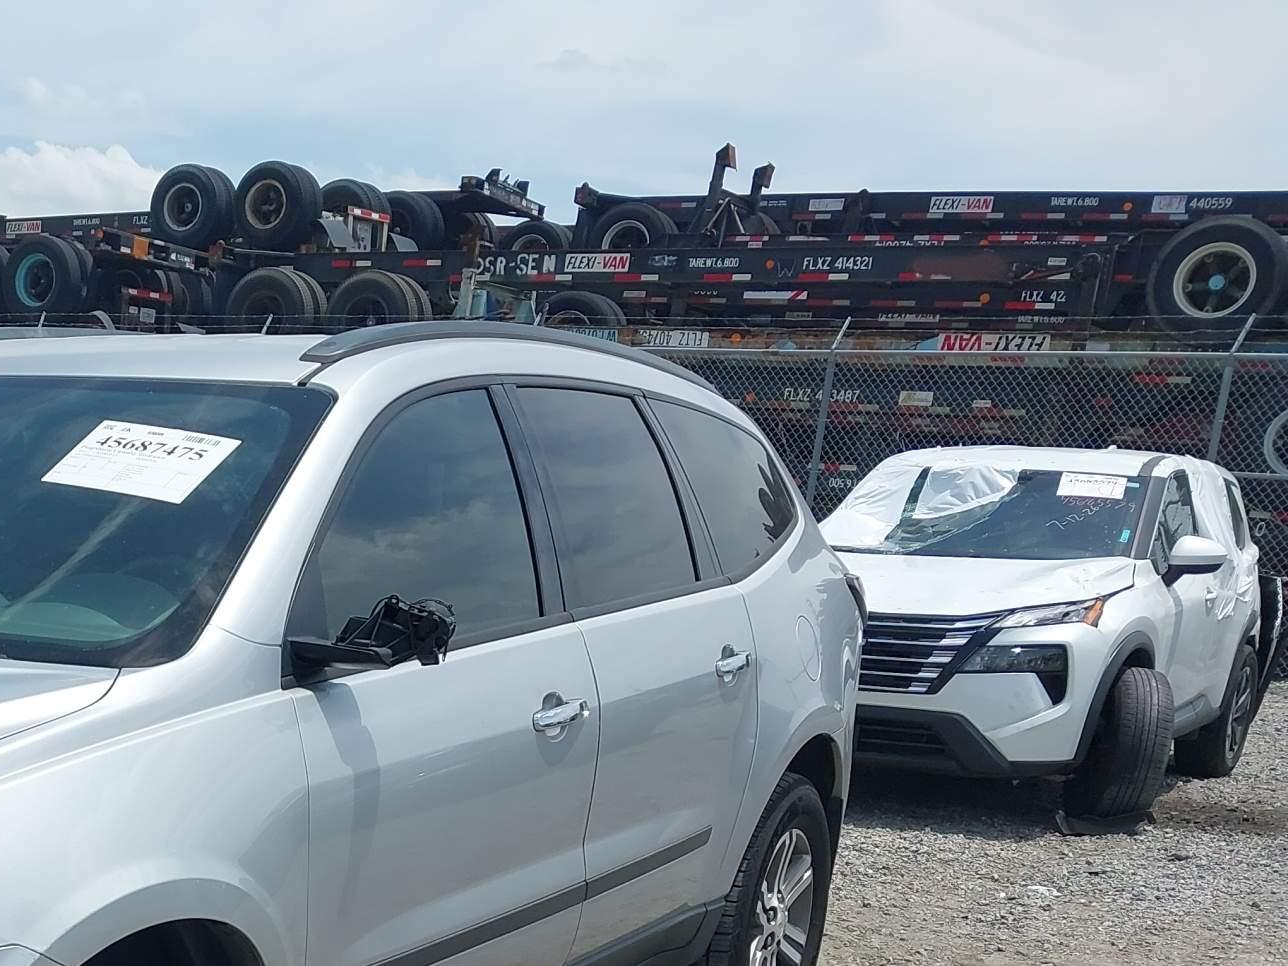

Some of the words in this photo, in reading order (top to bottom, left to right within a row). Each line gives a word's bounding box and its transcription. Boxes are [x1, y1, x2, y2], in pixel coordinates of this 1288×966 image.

[929, 196, 994, 213] FLEXI-VAN
[1189, 197, 1233, 209] 440559
[566, 254, 629, 270] FLEXI-VAN
[802, 257, 831, 270] FLXZ
[834, 256, 873, 270] 414321
[1021, 290, 1044, 302] FLXZ
[678, 330, 703, 346] FLTZ
[940, 335, 1047, 351] FLEXI-VAN
[783, 388, 811, 400] FLXZ
[96, 435, 209, 461] 45687475
